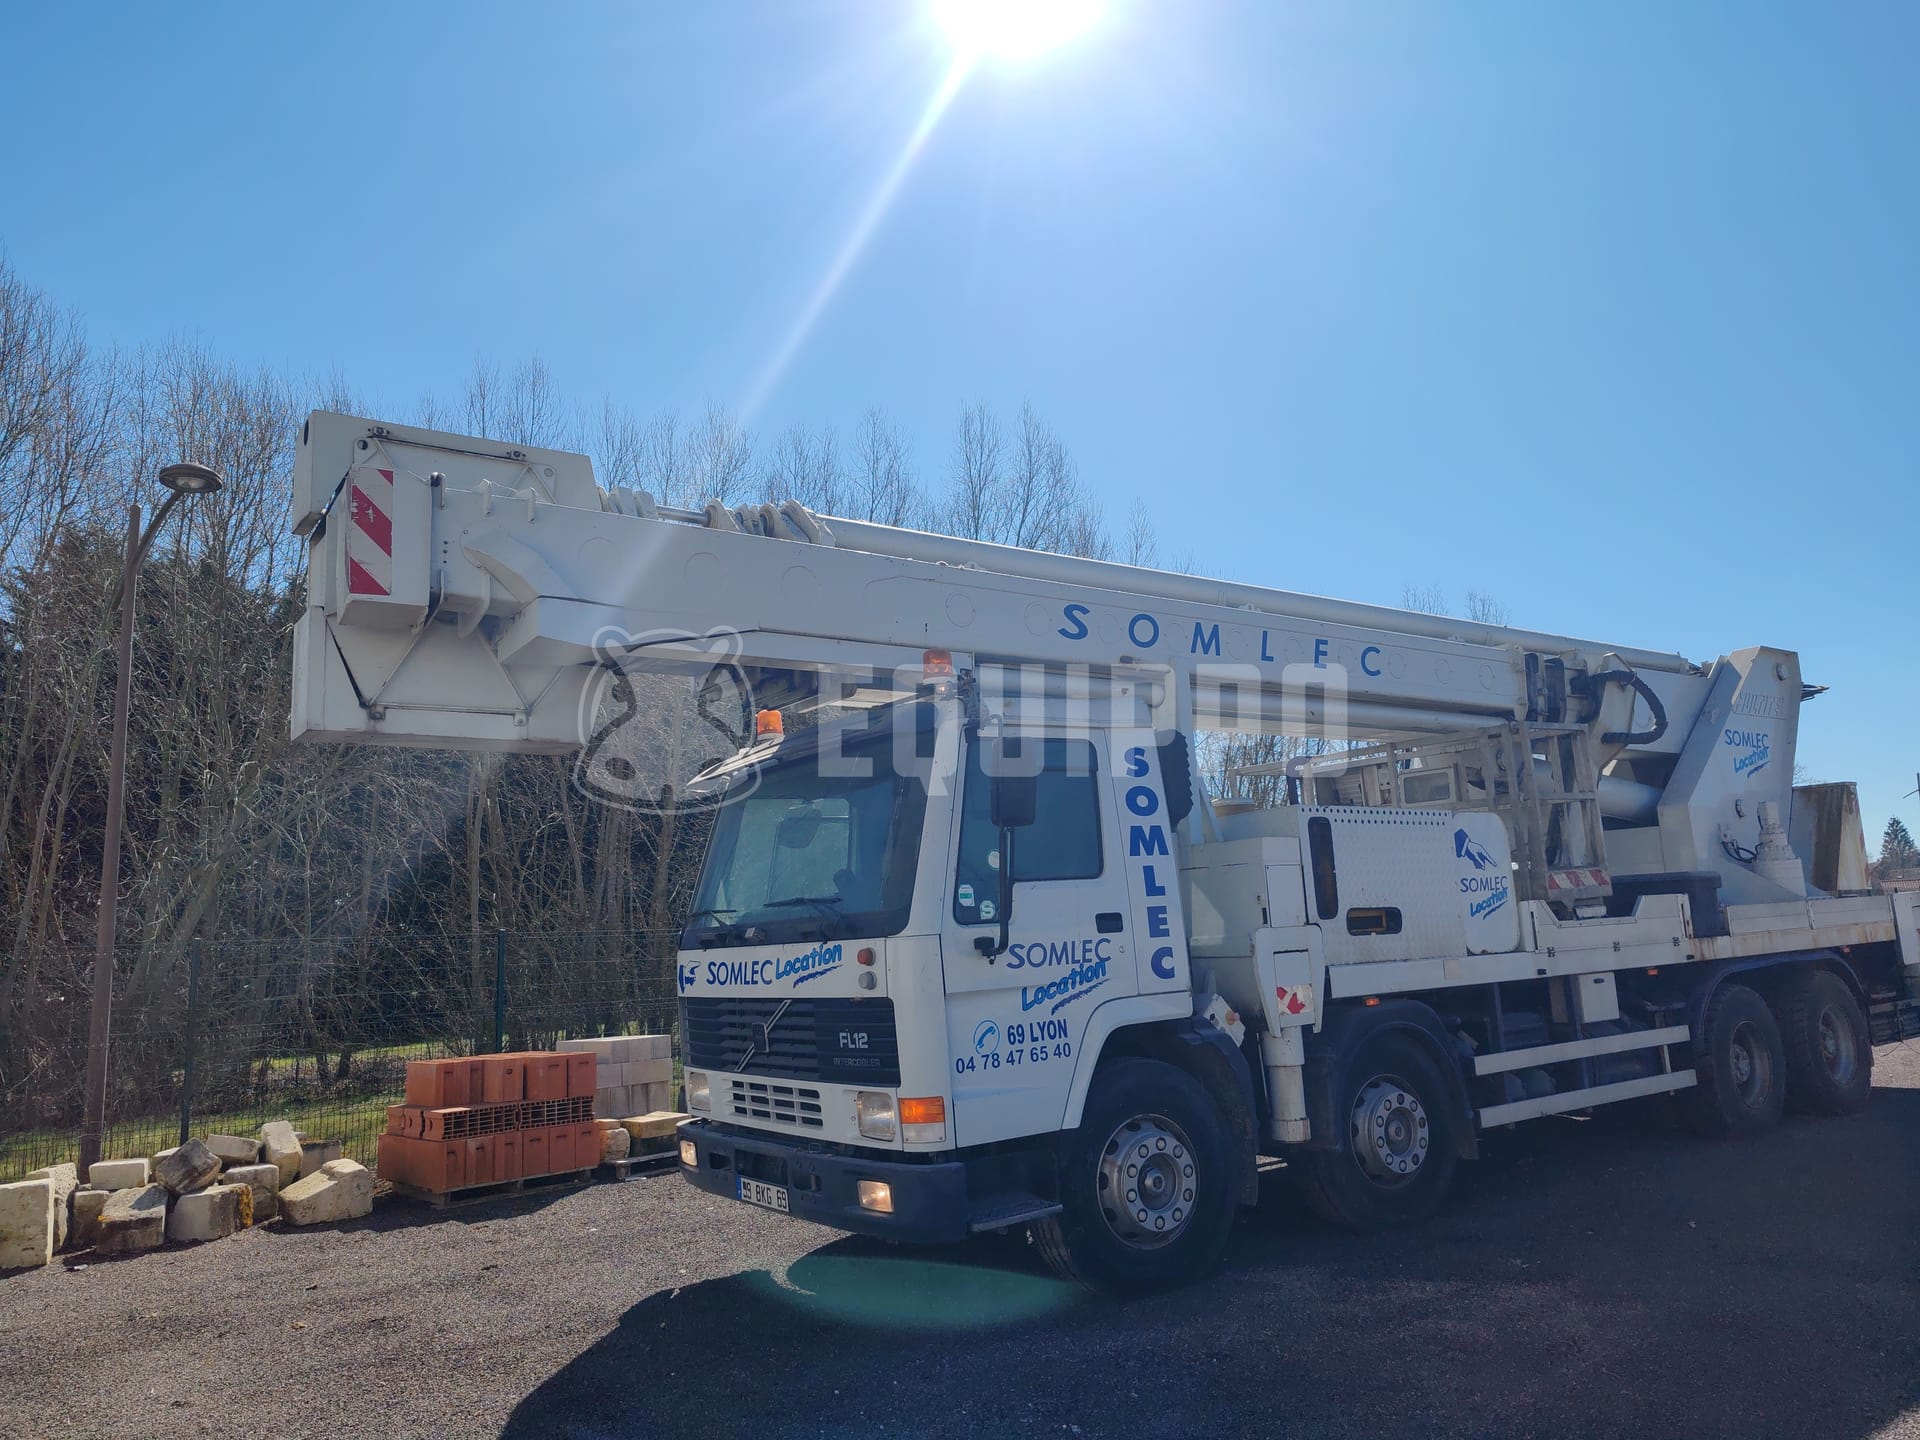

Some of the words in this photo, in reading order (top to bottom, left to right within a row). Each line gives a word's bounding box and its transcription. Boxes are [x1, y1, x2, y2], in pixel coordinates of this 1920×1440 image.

[1057, 604, 1383, 677] SOMLEC
[1725, 729, 1769, 750] SOMLEC
[1733, 748, 1769, 774] Location
[1124, 748, 1176, 980] SOMLEC
[1460, 876, 1509, 893] SOMLEC
[1469, 888, 1509, 917] Location
[706, 960, 773, 985] SOMLEC
[775, 943, 843, 980] Location
[1006, 938, 1112, 969] SOMLEC
[1021, 960, 1108, 1011] Location
[839, 1032, 869, 1049] FL12
[1007, 1023, 1025, 1045] 69
[1029, 1018, 1068, 1043] LYON
[956, 1056, 976, 1074] 04
[981, 1052, 1001, 1070] 78
[1006, 1049, 1024, 1066] 47
[1030, 1046, 1048, 1063] 65
[1053, 1042, 1071, 1059] 40
